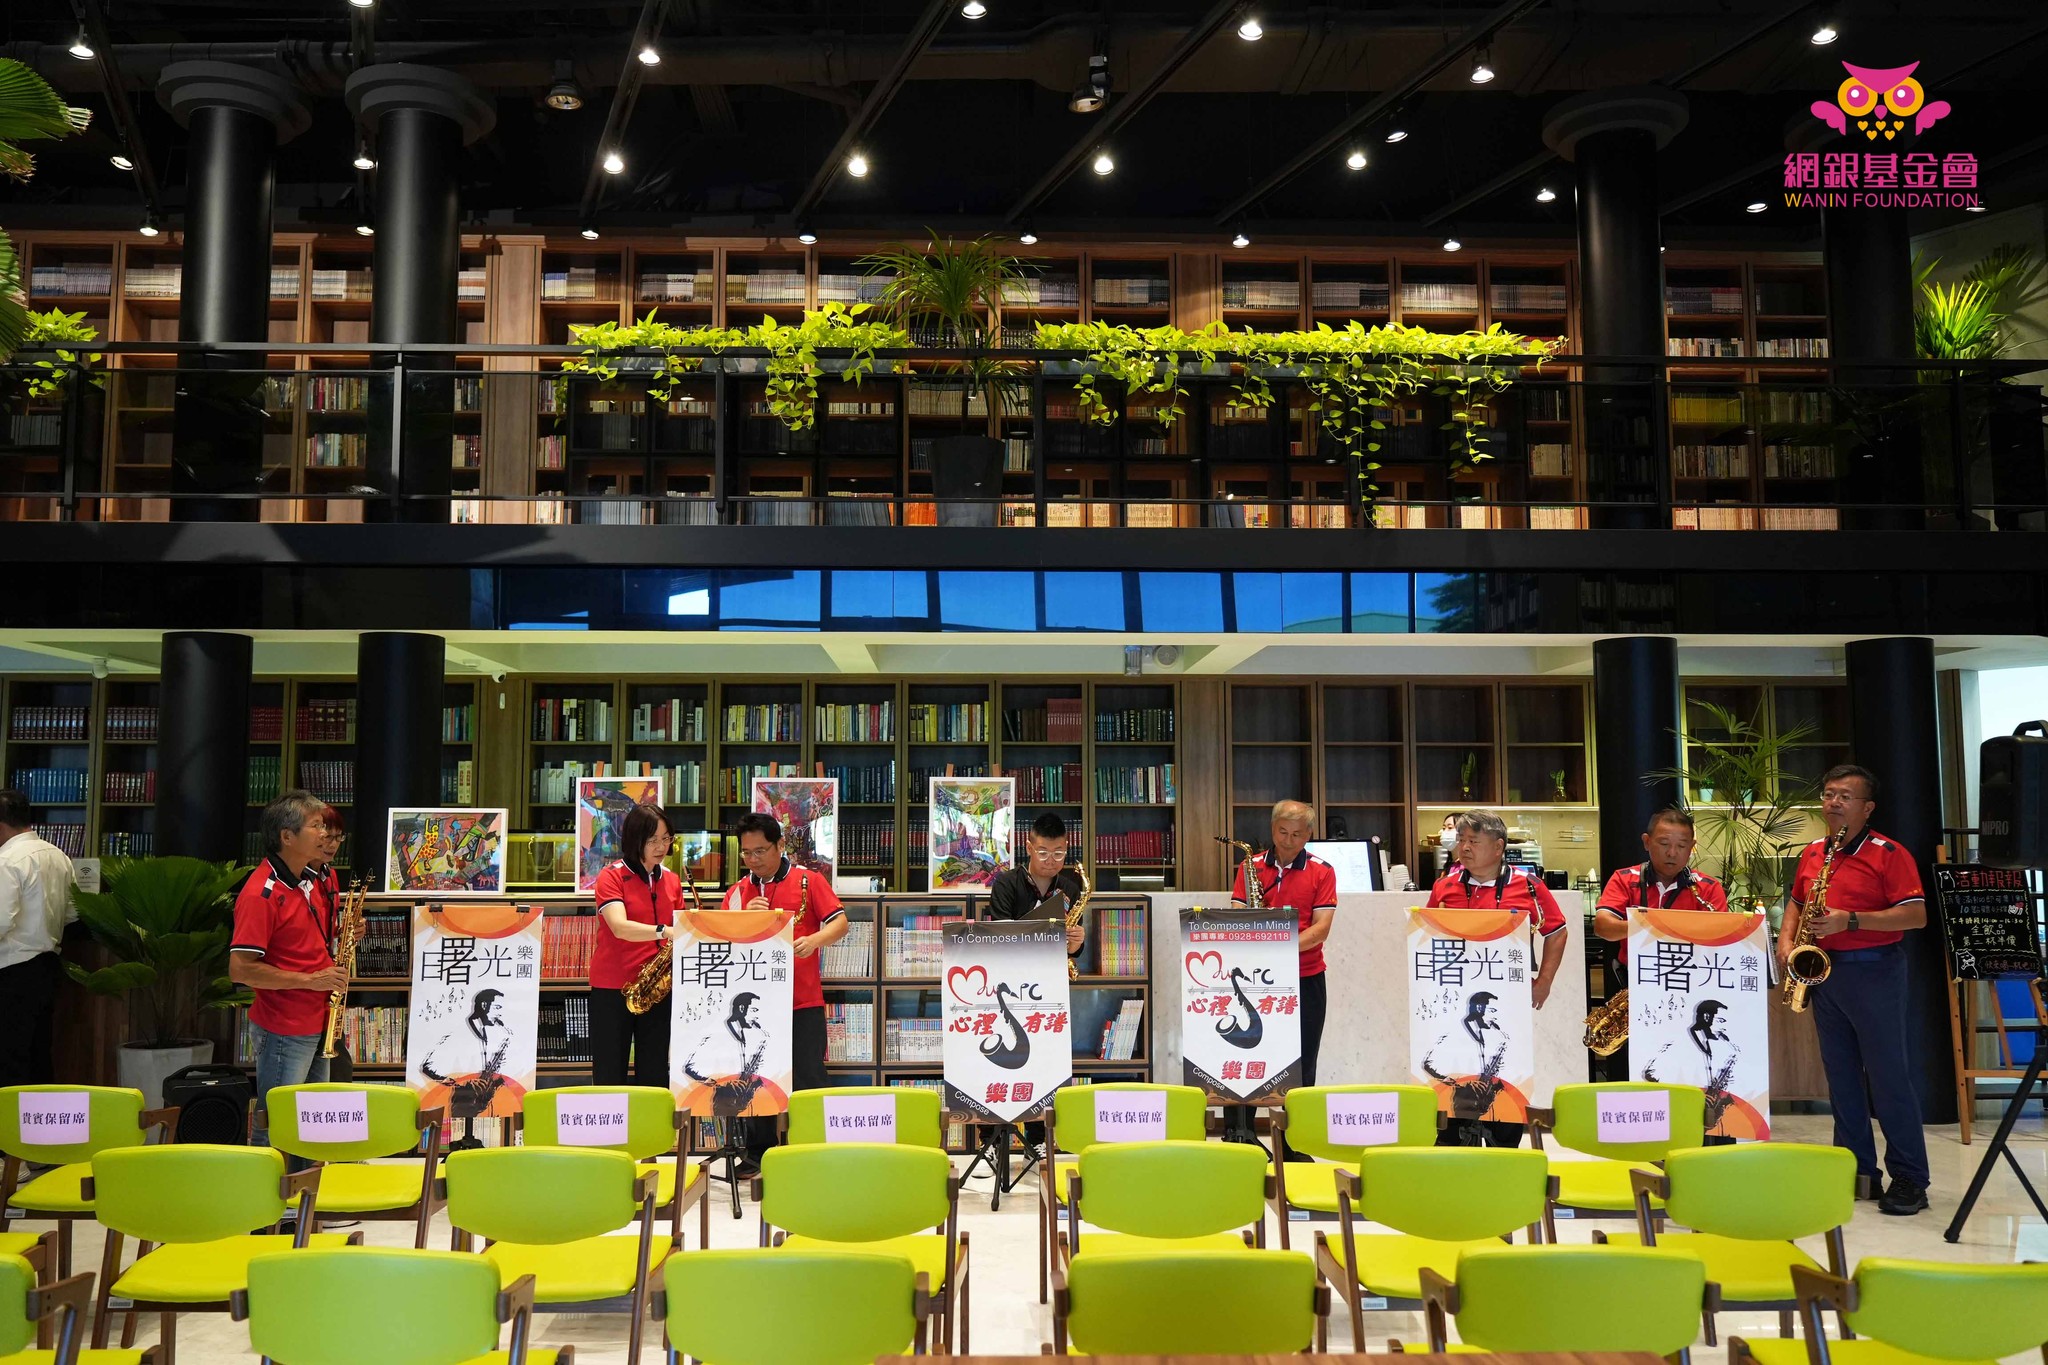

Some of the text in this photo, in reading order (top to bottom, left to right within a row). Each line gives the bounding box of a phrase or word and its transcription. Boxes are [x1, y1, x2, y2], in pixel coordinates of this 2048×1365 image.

[1982, 821, 2009, 835] MIPRO
[1188, 920, 1291, 932] To Compose In Mind
[1971, 924, 2006, 935] 全飲品
[951, 932, 1060, 944] To Compose In Mind
[421, 936, 513, 985] 曙光
[516, 945, 533, 979] 樂團
[681, 941, 786, 989] 曙光 樂團
[1415, 938, 1524, 987] 曙光 樂團
[1637, 940, 1758, 993] 曙光 樂團
[1221, 1061, 1266, 1080] 樂團
[1192, 1067, 1226, 1091] Compose
[1263, 1070, 1290, 1091] In Mind
[985, 1083, 1034, 1103] 樂團
[954, 1091, 990, 1115] Compose
[300, 1110, 365, 1125] 貴賓保留席
[1030, 1106, 1040, 1115] In
[1099, 1110, 1162, 1124] 貴賓保留席
[1602, 1110, 1665, 1124] 貴賓保留席
[22, 1112, 86, 1125] 貴賓保留席
[560, 1112, 624, 1126] 貴賓保留席
[829, 1114, 892, 1128] 貴賓保留席
[1332, 1112, 1395, 1126] 貴賓保留席
